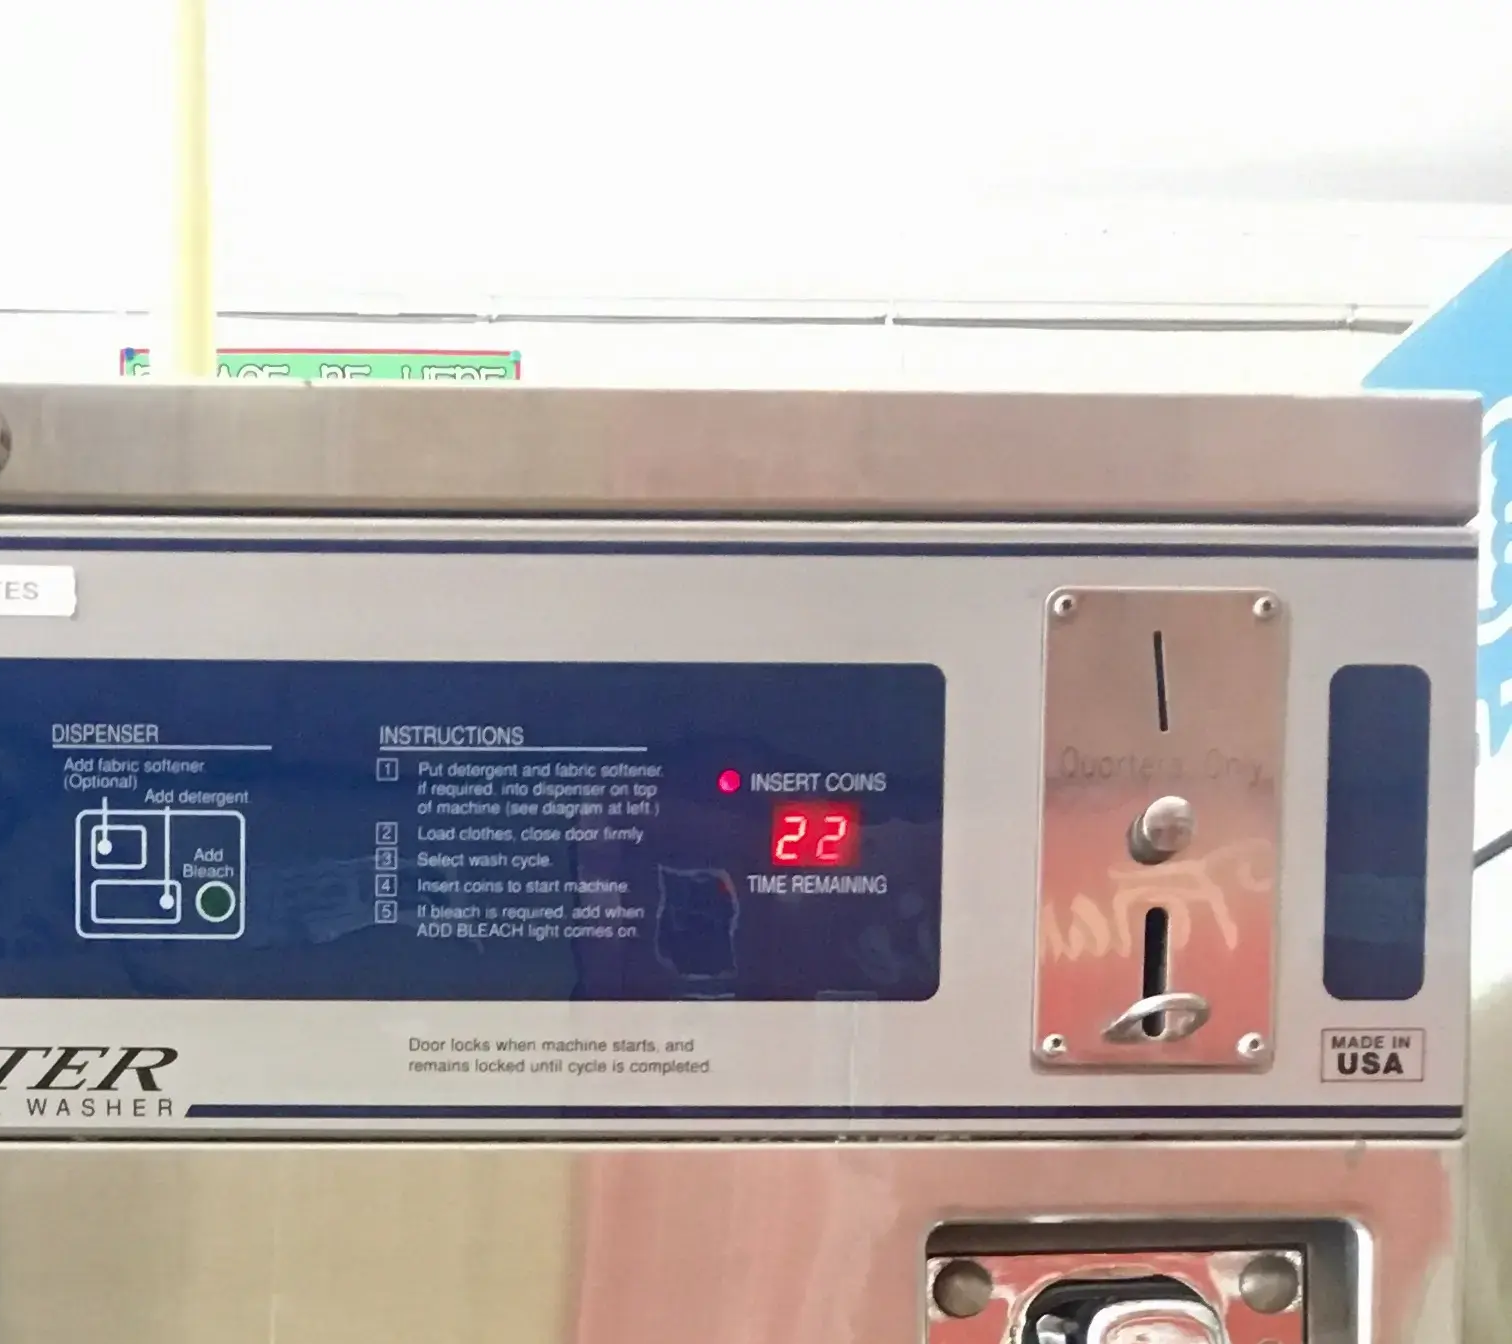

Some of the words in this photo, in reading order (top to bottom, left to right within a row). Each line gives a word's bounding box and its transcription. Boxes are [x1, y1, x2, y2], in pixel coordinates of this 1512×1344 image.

[51, 724, 160, 744] DISPENSER
[379, 726, 525, 746] INSTRUCTIONS
[64, 757, 94, 773] Add
[97, 757, 140, 773] fabric
[418, 762, 443, 780] Put
[448, 762, 518, 780] detergent
[522, 762, 550, 780] and
[555, 762, 596, 780] fabric
[1204, 748, 1265, 790] Ony
[63, 775, 138, 790] (Optional)
[750, 773, 819, 792] INSERT
[824, 773, 887, 792] COINS
[144, 789, 174, 804] Add
[417, 783, 427, 799] if
[501, 783, 529, 799] into
[533, 783, 605, 799] dispenser
[609, 783, 629, 799] on
[633, 783, 657, 799] top
[417, 802, 433, 818] of
[437, 802, 500, 818] machine
[505, 802, 538, 818] (see
[542, 802, 603, 818] diagram
[608, 802, 622, 818] at
[417, 827, 455, 843] Load
[521, 827, 561, 843] close
[565, 827, 598, 843] door
[774, 815, 848, 861] 22
[193, 848, 224, 862] Add
[417, 853, 464, 870] Select
[468, 853, 508, 870] wash
[183, 864, 234, 879] Bleach
[417, 880, 460, 893] Insert
[463, 880, 504, 893] coins
[507, 880, 522, 893] to
[525, 880, 560, 893] start
[747, 875, 788, 894] TIME
[791, 875, 888, 894] REMAINING
[417, 905, 427, 921] If
[430, 905, 480, 921] bleach
[485, 905, 497, 921] is
[571, 905, 602, 921] add
[604, 905, 645, 921] when
[417, 924, 452, 941] ADD
[457, 924, 524, 941] BLEACH
[528, 924, 559, 941] light
[563, 924, 613, 941] comes
[409, 1038, 445, 1053] Door
[451, 1038, 490, 1053] locks
[496, 1038, 536, 1053] when
[542, 1038, 607, 1053] machine
[665, 1038, 694, 1053] and
[1332, 1036, 1388, 1050] MADE
[1393, 1036, 1411, 1050] IN
[409, 1059, 470, 1074] remains
[475, 1059, 525, 1074] locked
[530, 1059, 563, 1074] until
[568, 1059, 607, 1074] cycle
[613, 1059, 625, 1074] is
[1337, 1053, 1405, 1075] USA
[27, 1096, 174, 1118] WASHER
